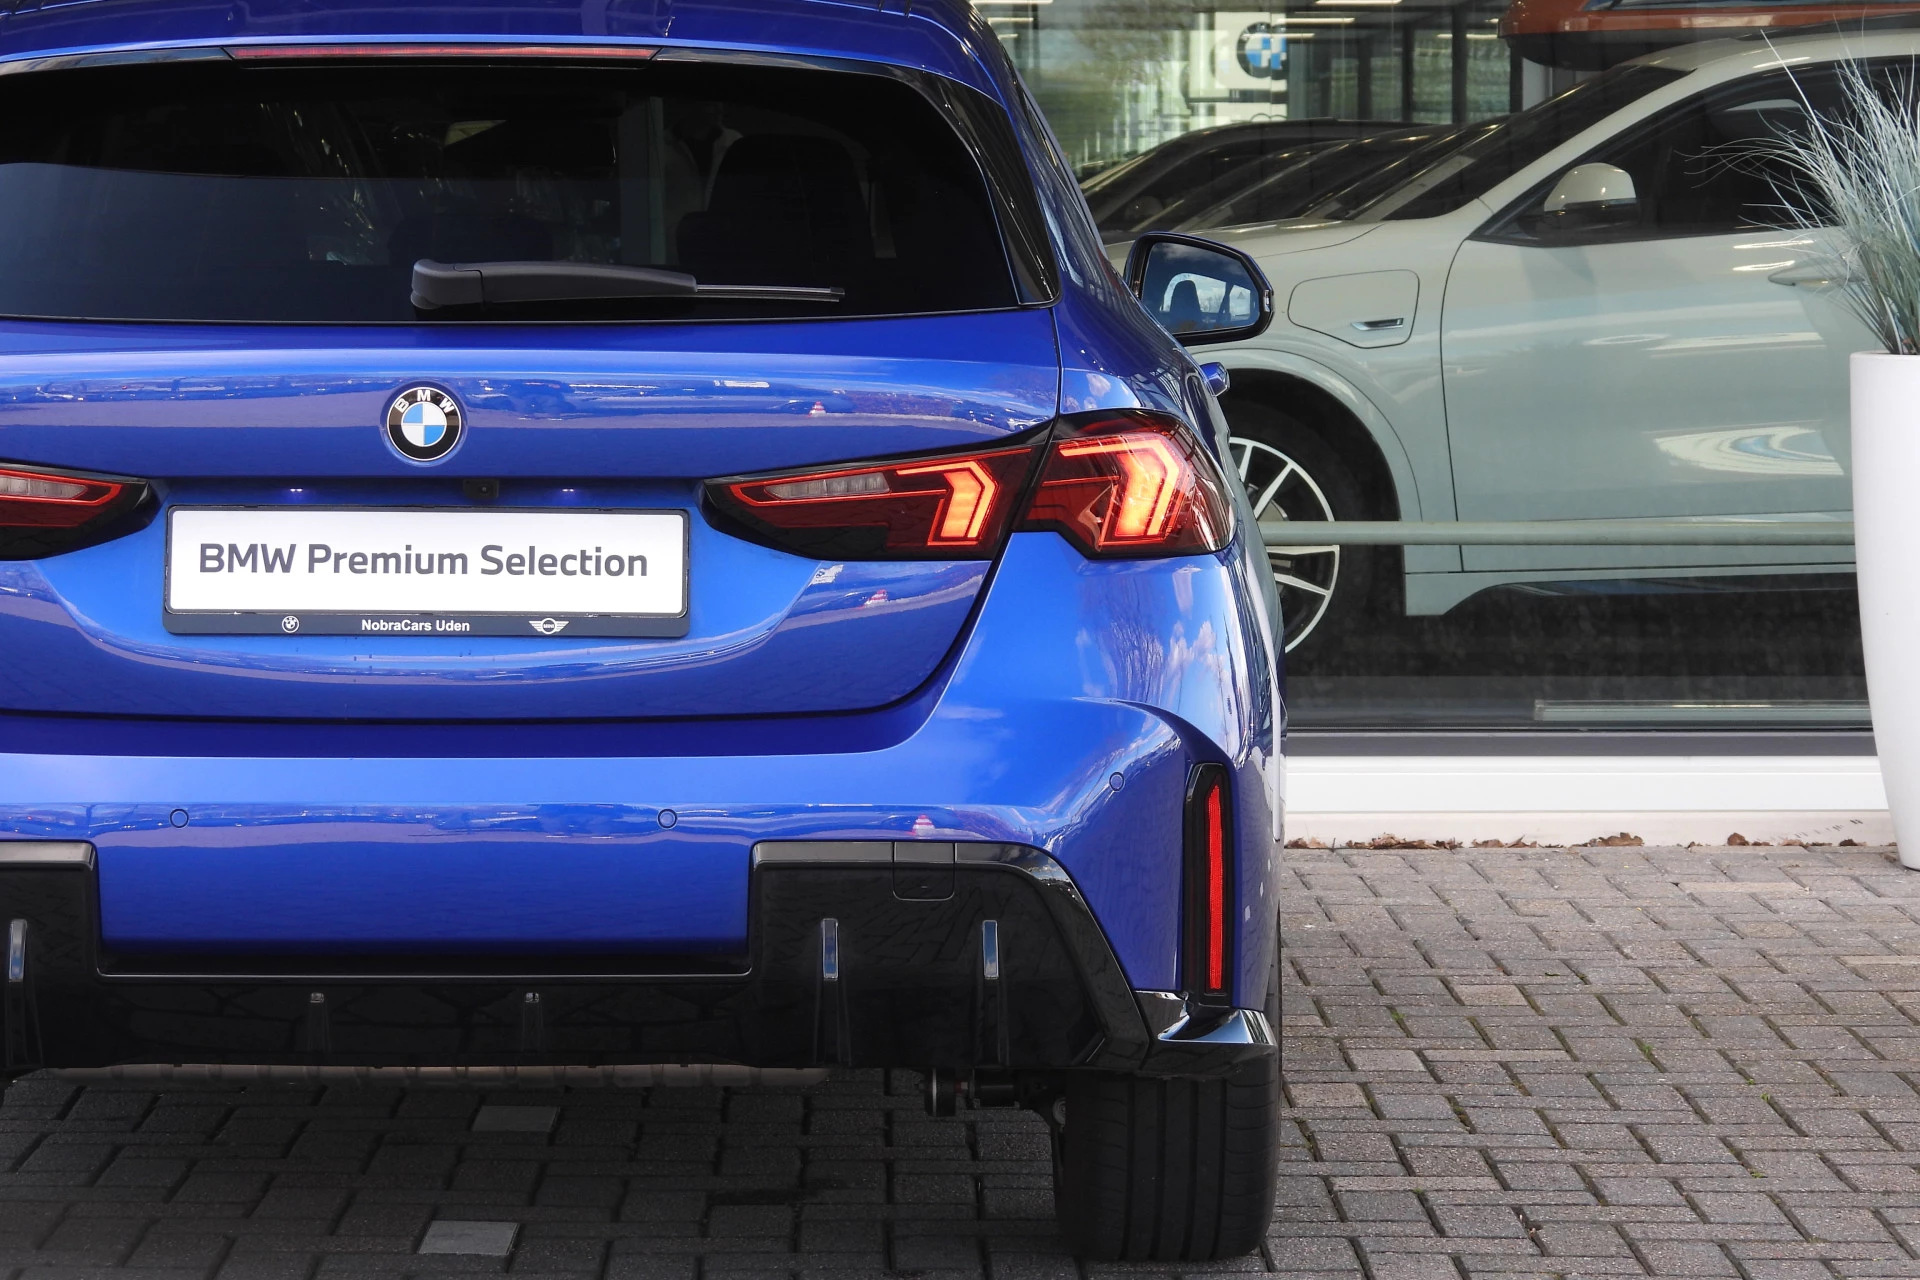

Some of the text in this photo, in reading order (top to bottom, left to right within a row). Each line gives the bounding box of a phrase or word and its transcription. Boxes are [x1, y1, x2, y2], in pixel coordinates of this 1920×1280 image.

[394, 389, 455, 413] BMW
[199, 543, 648, 577] BMW Premium Selection
[361, 619, 470, 632] NobraCars Uden
